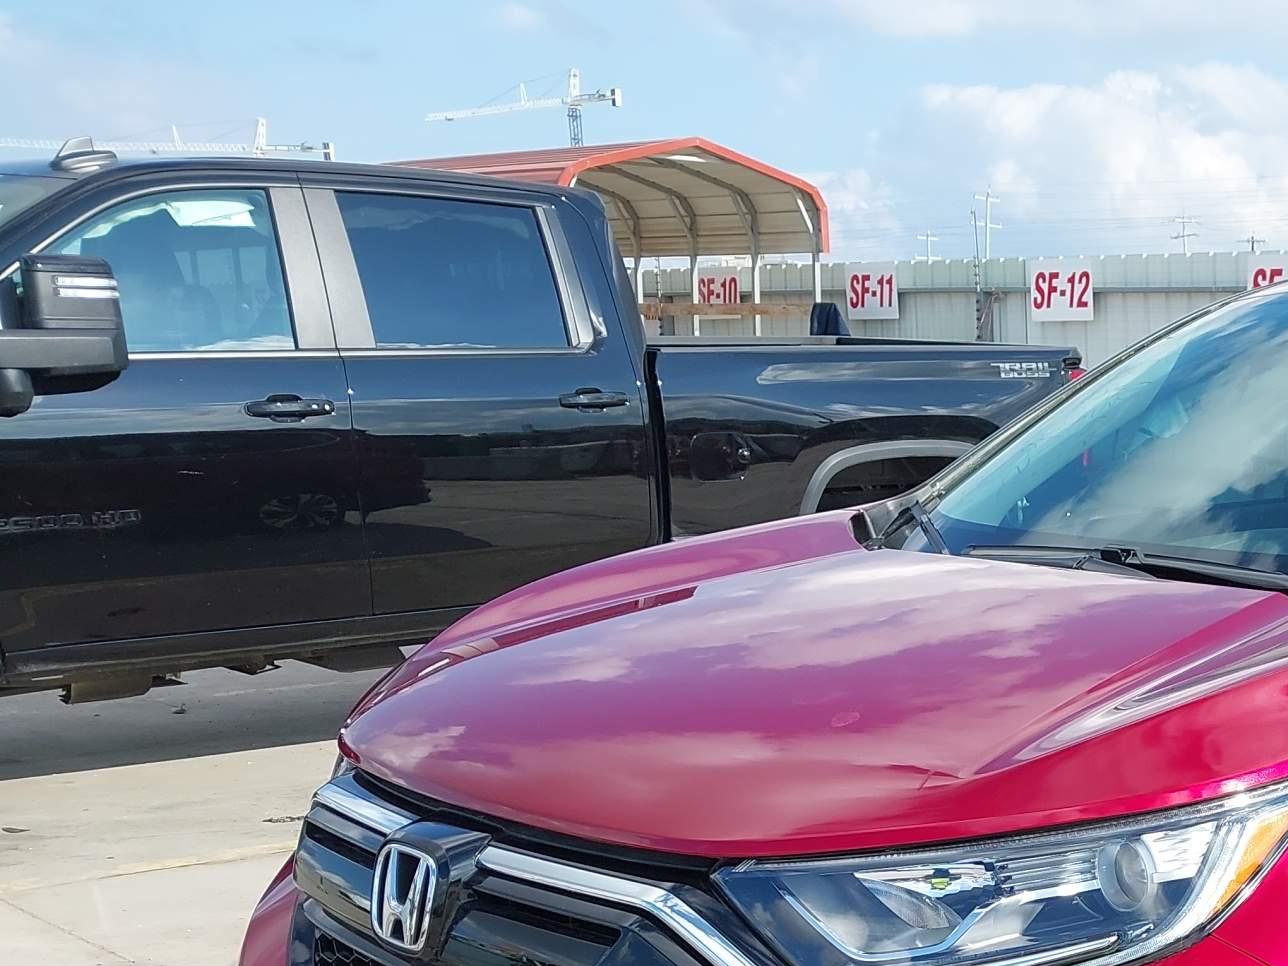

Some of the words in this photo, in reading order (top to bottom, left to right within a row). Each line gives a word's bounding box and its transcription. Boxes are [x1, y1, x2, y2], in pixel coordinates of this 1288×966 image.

[698, 276, 738, 305] SF-10
[849, 273, 894, 309] SF-11
[1032, 270, 1091, 310] SF-12
[990, 362, 1057, 371] TRAIL
